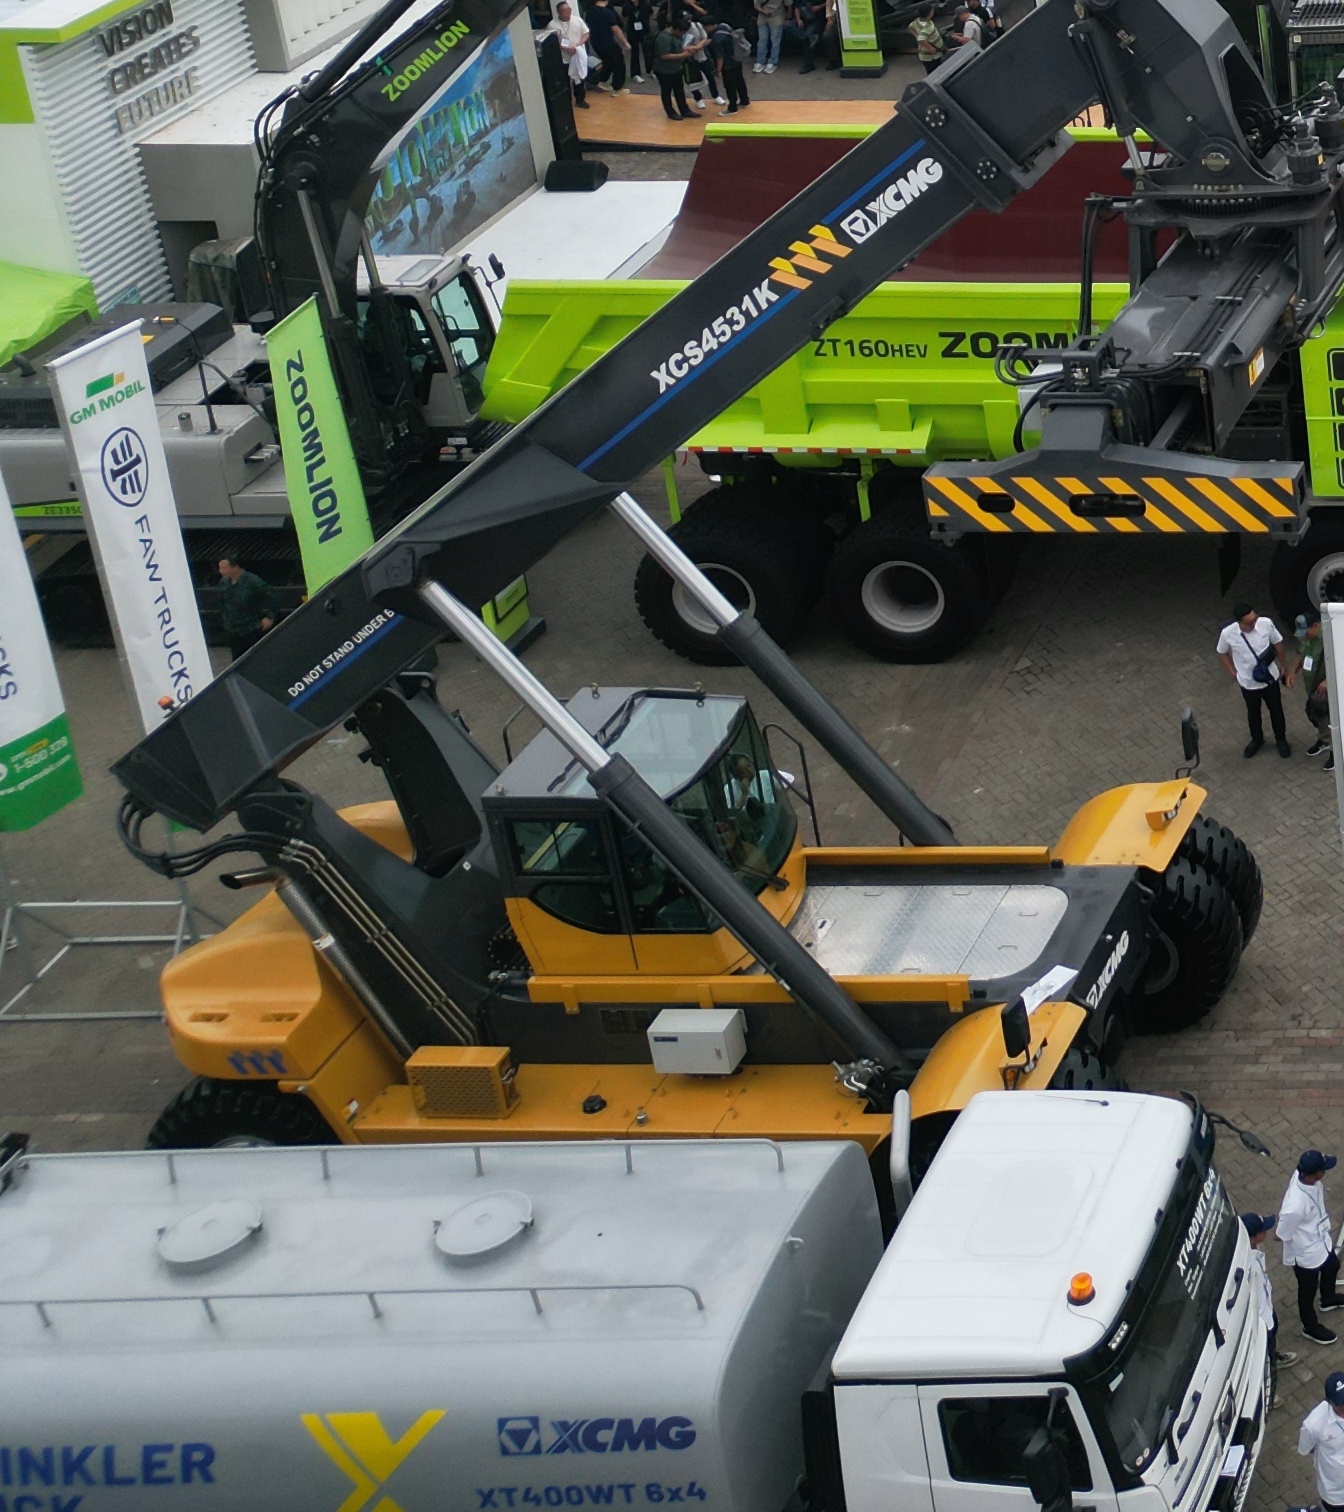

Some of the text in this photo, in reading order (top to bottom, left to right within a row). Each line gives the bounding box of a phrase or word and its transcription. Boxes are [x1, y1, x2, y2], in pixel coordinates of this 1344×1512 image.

[107, 25, 201, 95] CREATES
[380, 18, 471, 103] ZOOMLION
[114, 66, 200, 136] FUTURE
[870, 157, 944, 228] XCMG
[650, 281, 780, 394] XCS4531K
[813, 338, 928, 360] ZT160HEV
[69, 380, 146, 425] GM MOBIL
[286, 348, 343, 547] ZOOMLION
[134, 515, 194, 705] FAW TRUCKS
[287, 615, 383, 699] DO NOT STAND UNDER
[0, 1441, 216, 1487] INKLER
[548, 1416, 697, 1454] XCMG
[476, 1484, 636, 1510] XT400WT
